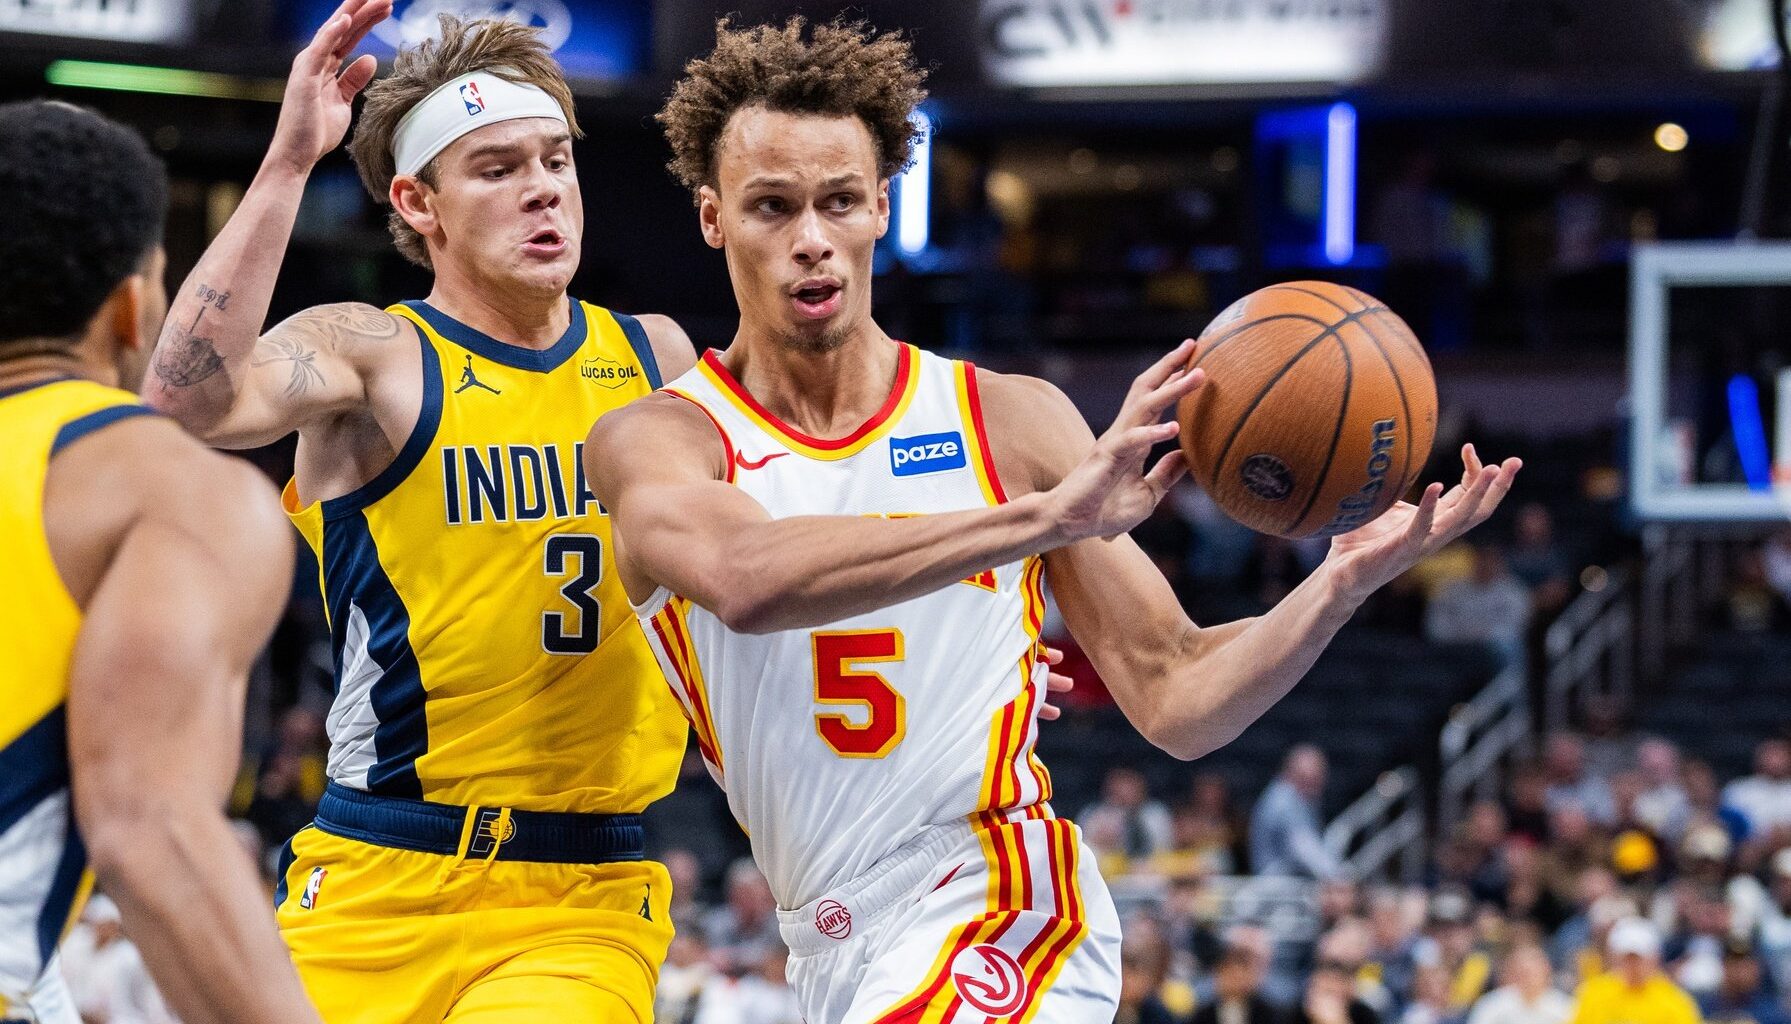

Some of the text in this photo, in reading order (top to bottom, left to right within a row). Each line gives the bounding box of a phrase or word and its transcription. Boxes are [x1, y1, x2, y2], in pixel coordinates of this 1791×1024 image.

[580, 365, 639, 379] LUCAS OIL
[893, 441, 958, 467] paze
[541, 533, 603, 655] 3
[811, 627, 906, 759] 5
[814, 906, 851, 934] HAWKS
